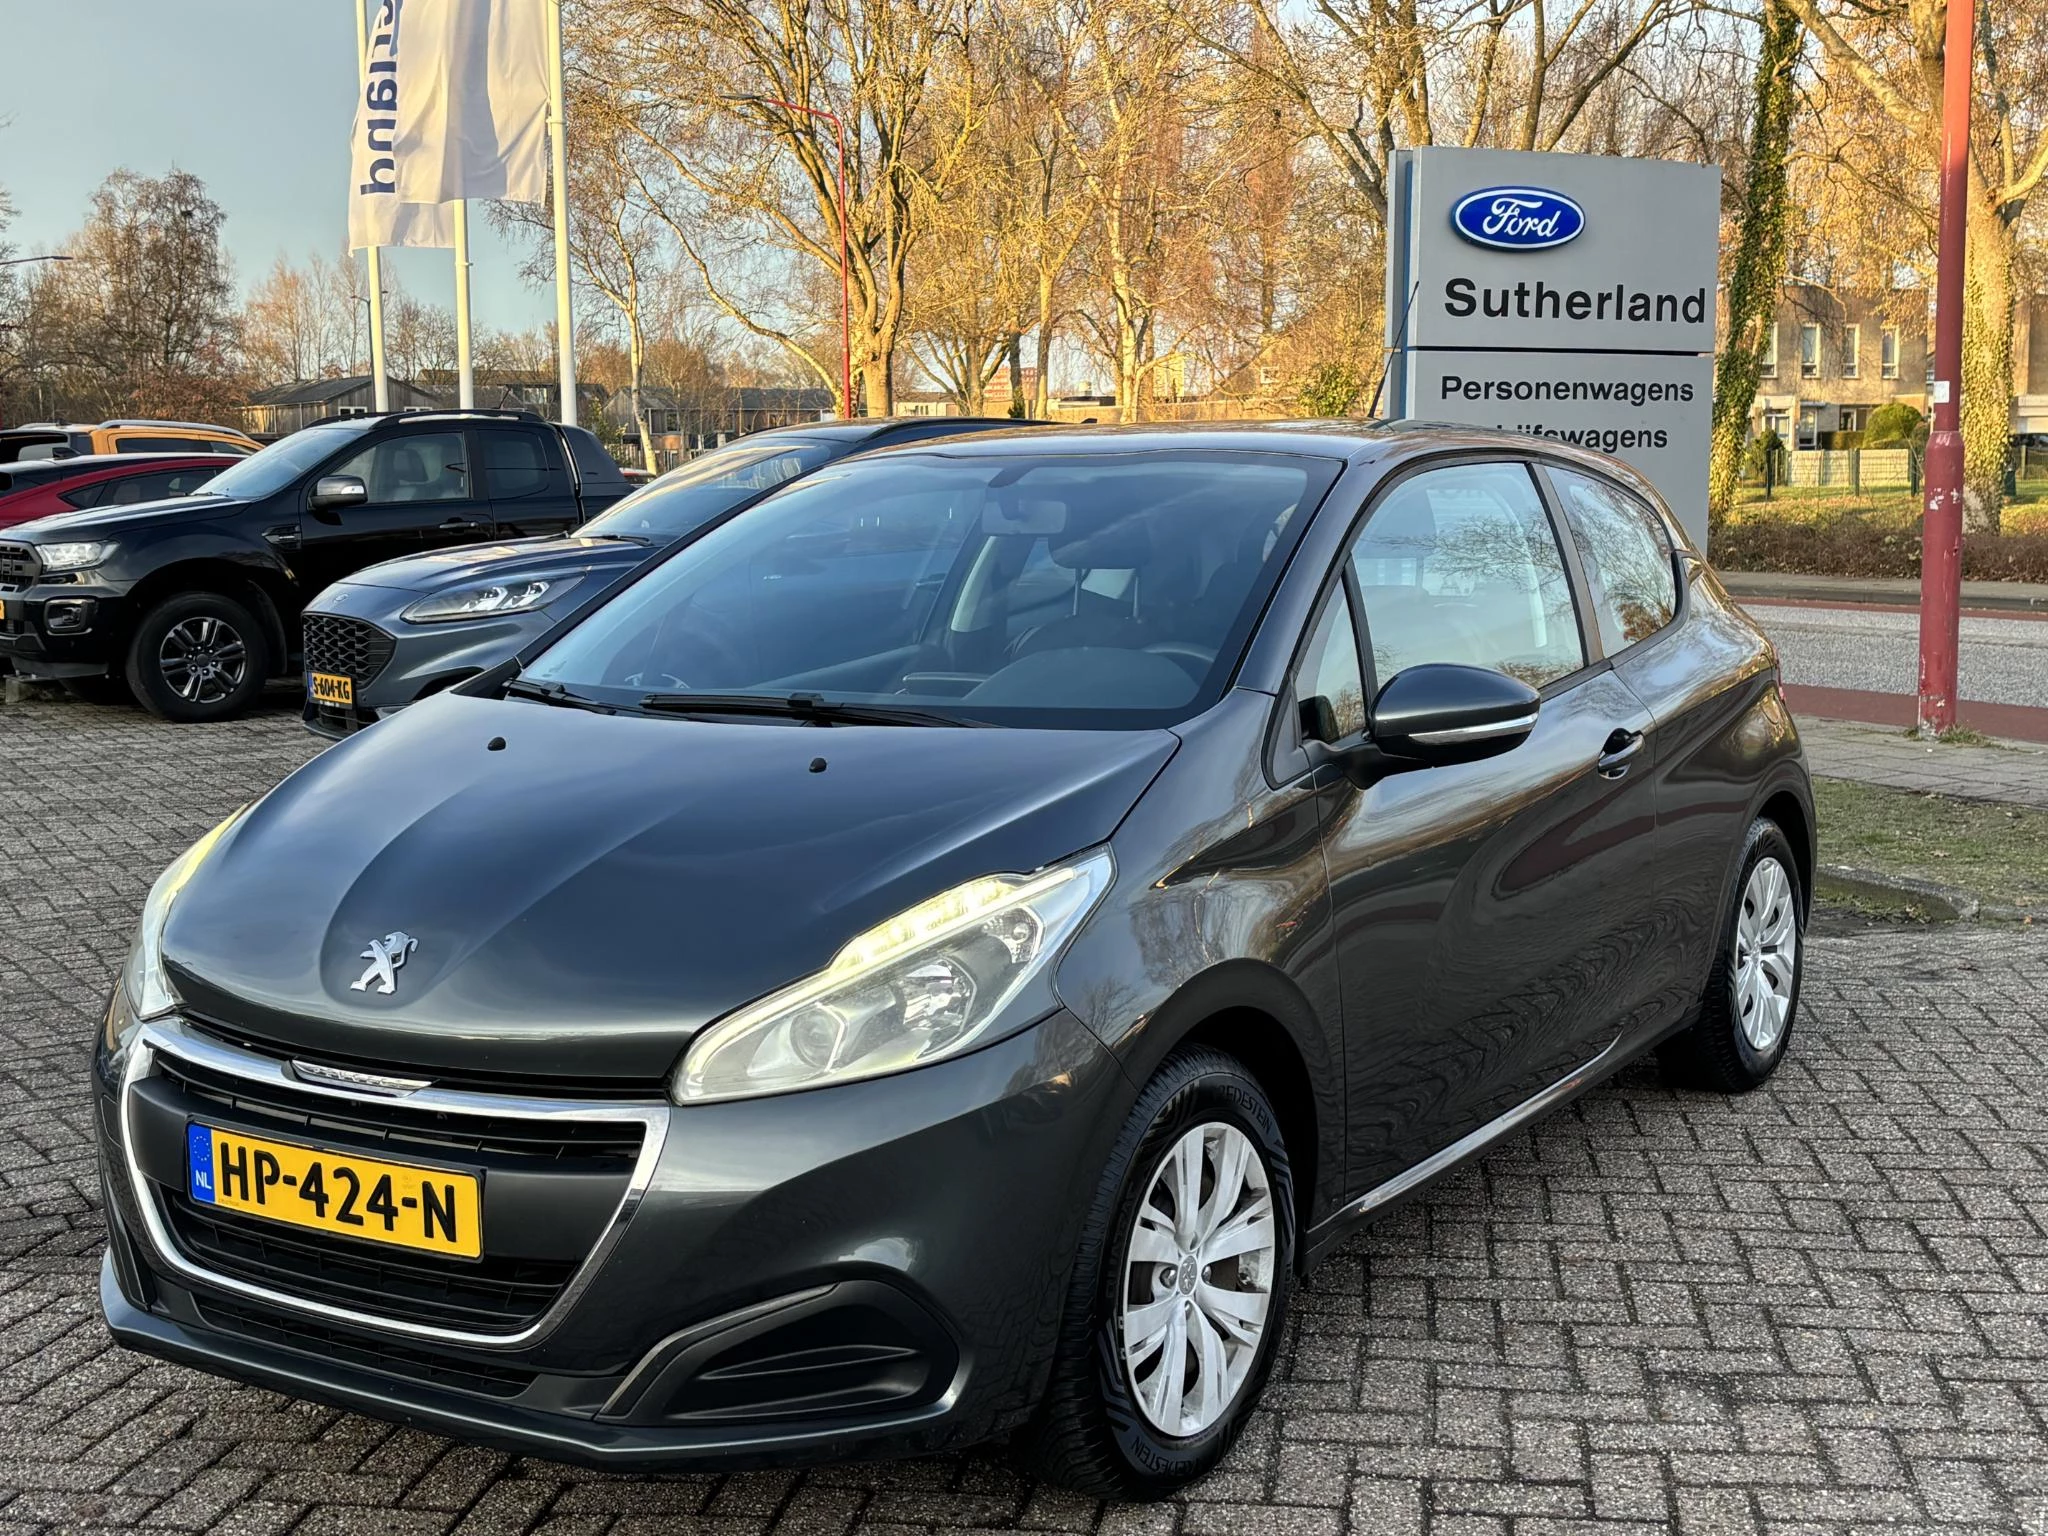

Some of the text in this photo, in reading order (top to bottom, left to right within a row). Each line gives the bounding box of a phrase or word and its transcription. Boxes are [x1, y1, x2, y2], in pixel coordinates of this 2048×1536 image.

[1482, 197, 1562, 238] Ford
[1445, 278, 1706, 323] Sutherland
[1441, 375, 1694, 407] Personenwagens
[313, 676, 351, 700] S-604-KG
[195, 1169, 212, 1190] NL
[220, 1141, 457, 1243] HP-424-N
